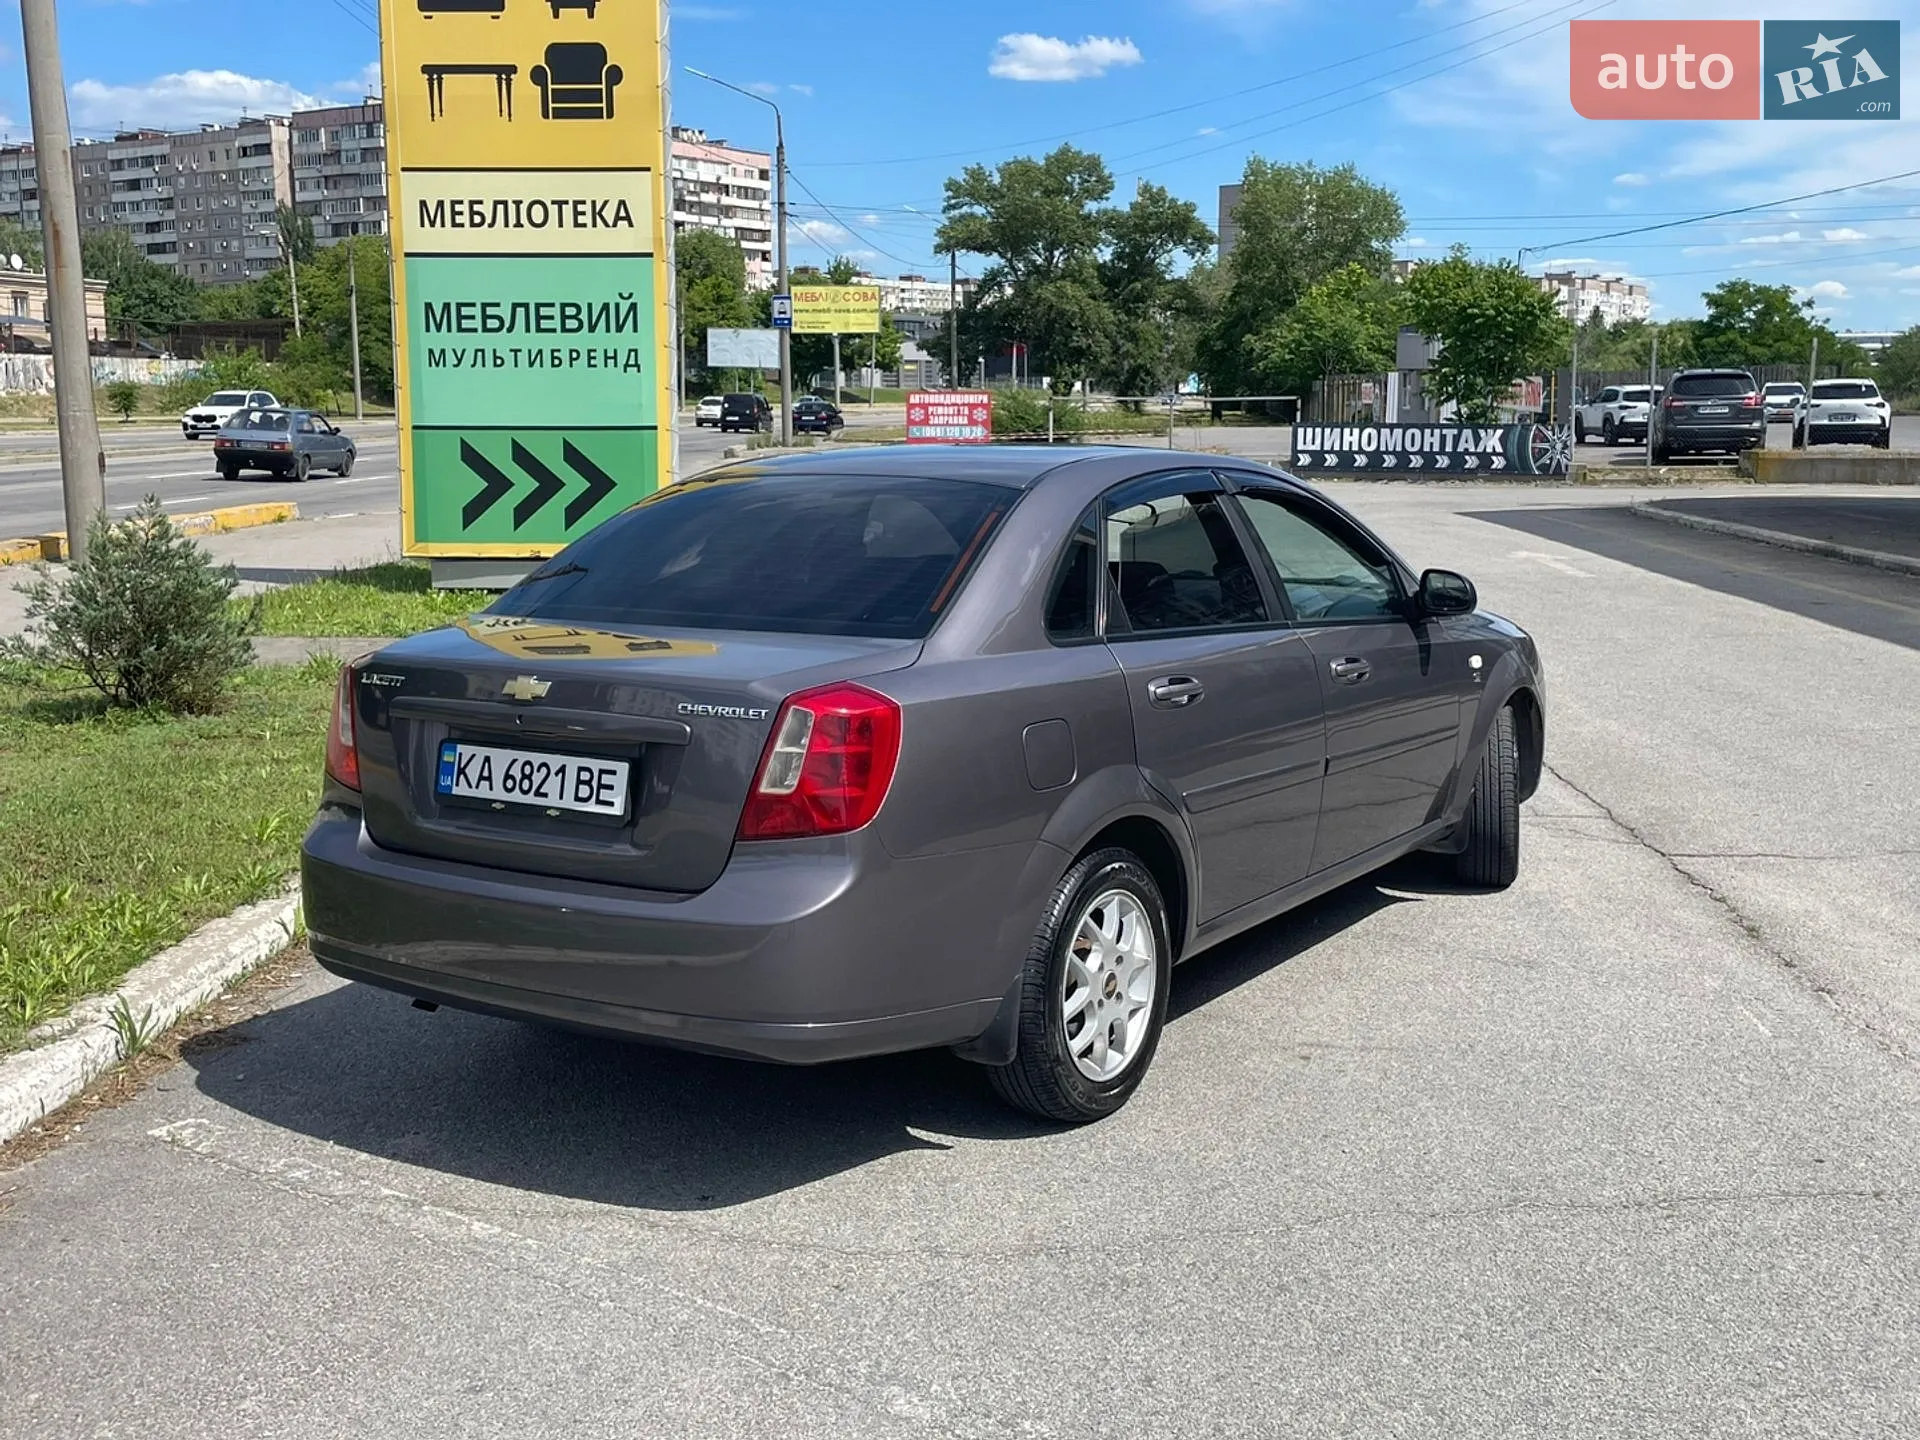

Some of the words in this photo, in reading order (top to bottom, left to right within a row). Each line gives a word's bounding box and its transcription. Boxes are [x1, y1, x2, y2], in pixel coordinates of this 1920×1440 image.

[418, 199, 635, 228] МЕБЛІОТЕКА
[842, 291, 878, 302] СОВА
[424, 292, 639, 333] МЕБЛЕВИЙ
[428, 348, 641, 373] МУЛЬТИБРЕНД
[928, 406, 958, 415] РЕМОНТ
[1297, 427, 1504, 453] ШИНОМОНТАЖ
[678, 702, 769, 720] CHEVROLET
[455, 752, 493, 791] KA
[502, 758, 567, 800] 6821
[573, 766, 617, 807] BE
